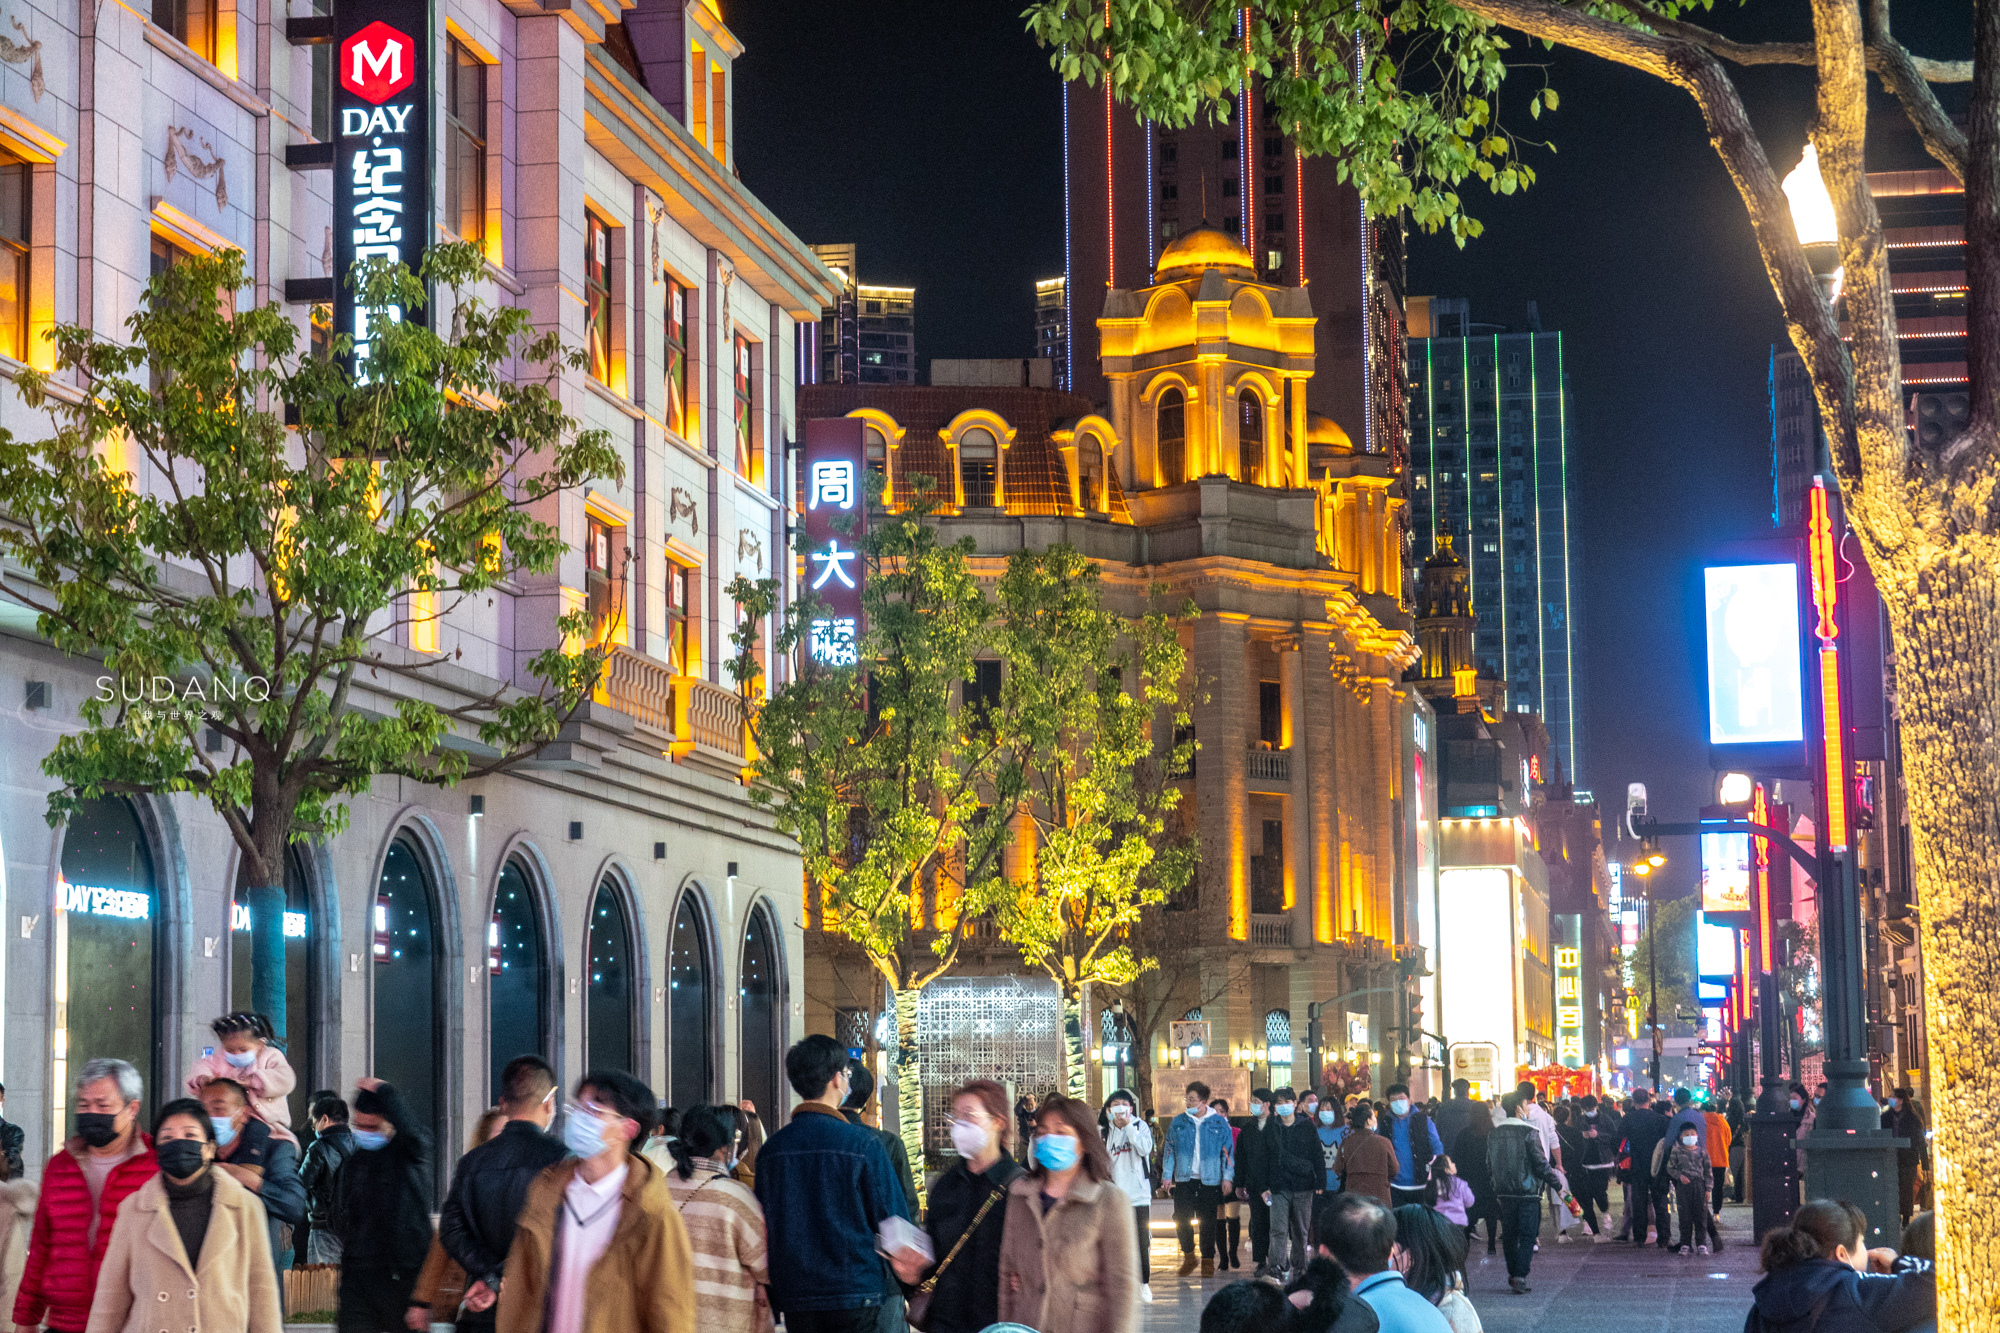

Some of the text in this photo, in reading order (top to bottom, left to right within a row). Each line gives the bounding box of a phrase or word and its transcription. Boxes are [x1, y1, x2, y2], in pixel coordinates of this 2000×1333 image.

[341, 104, 414, 136] DAY
[809, 460, 858, 667] 周大福
[1557, 947, 1581, 1059] 中心百货
